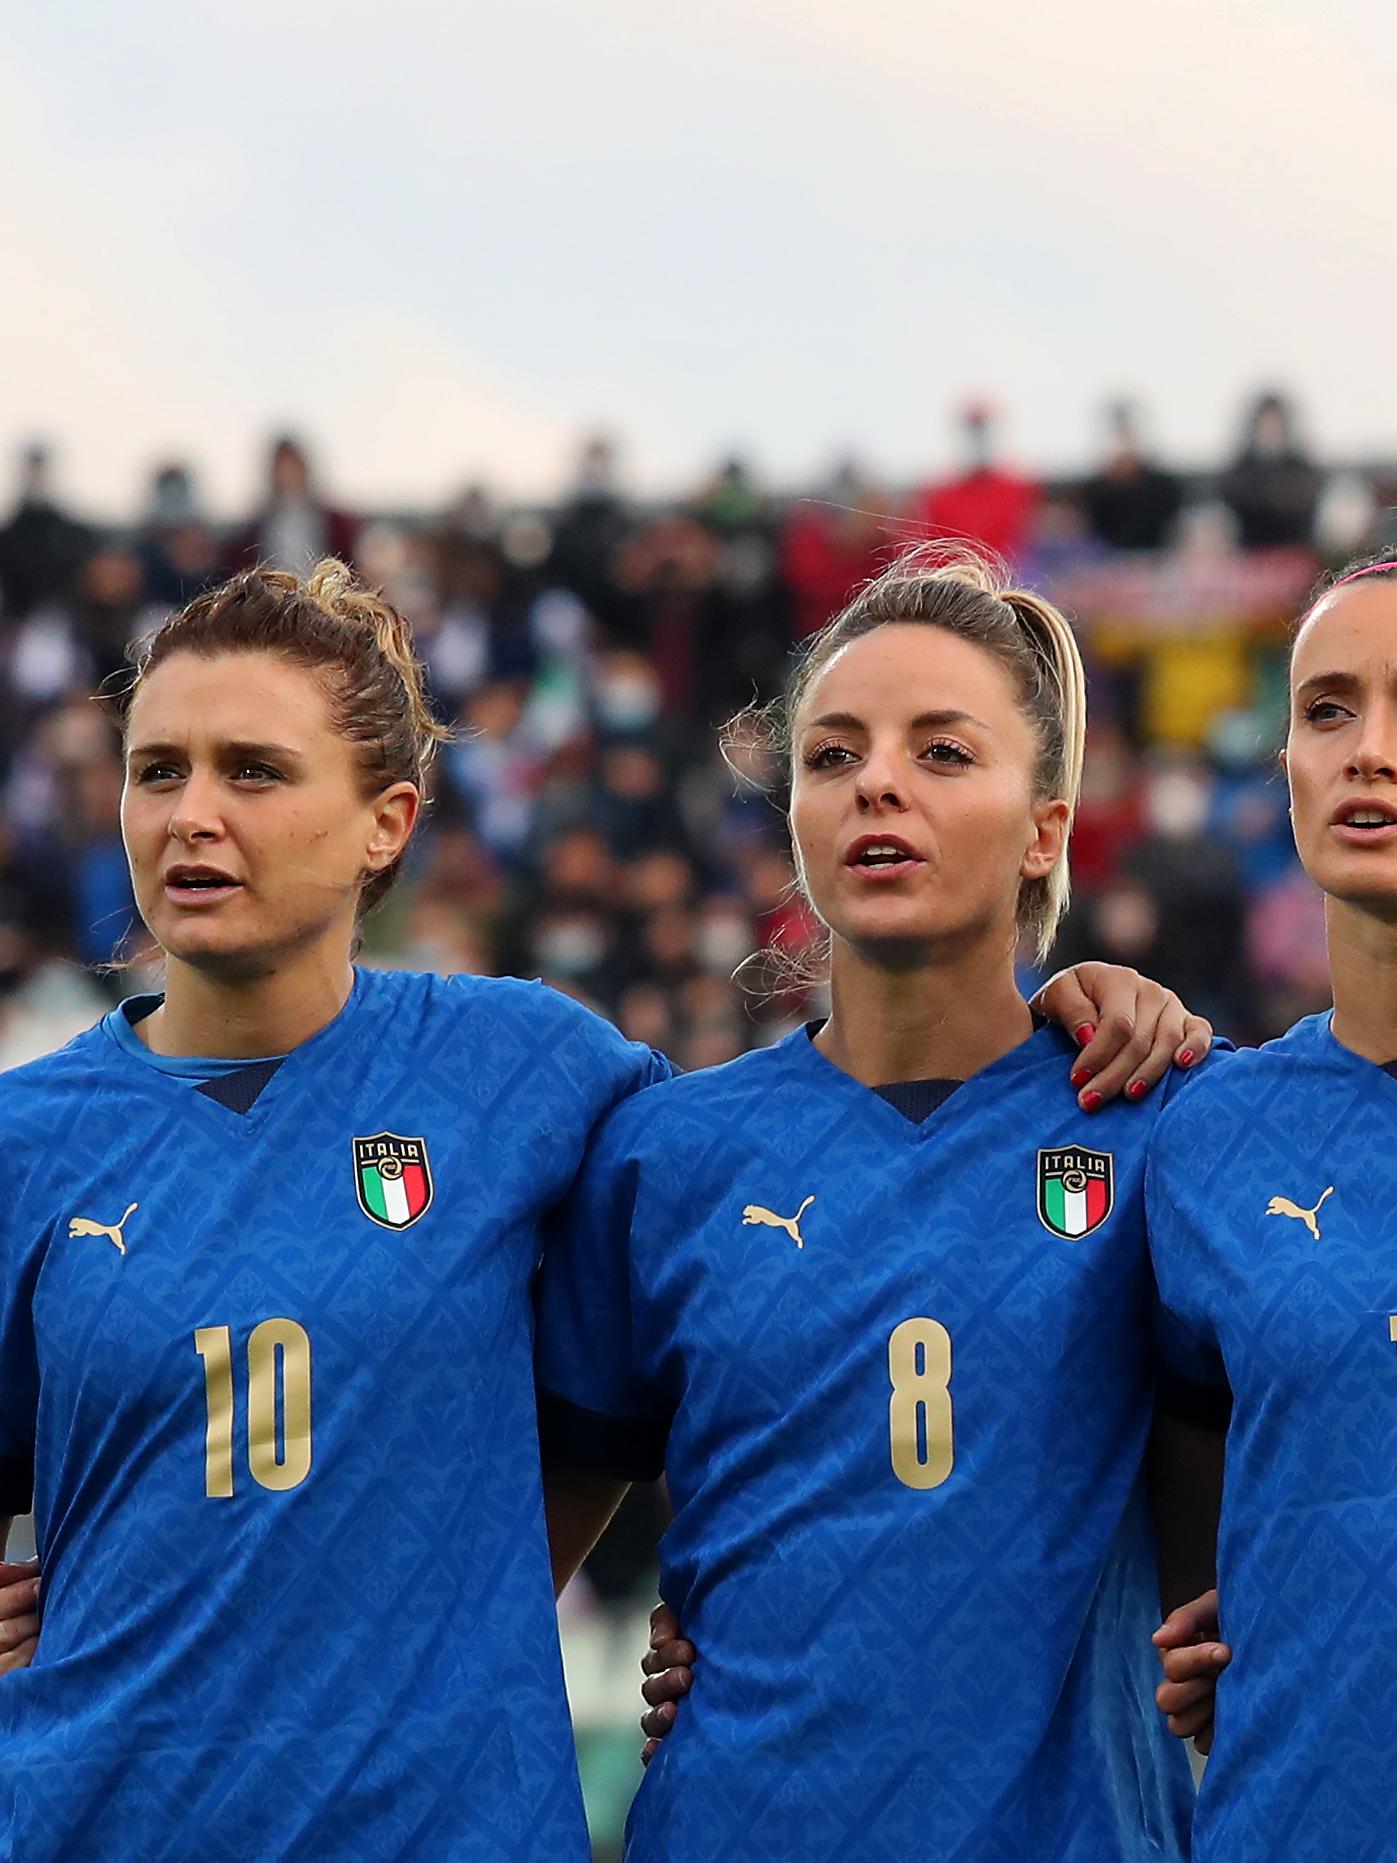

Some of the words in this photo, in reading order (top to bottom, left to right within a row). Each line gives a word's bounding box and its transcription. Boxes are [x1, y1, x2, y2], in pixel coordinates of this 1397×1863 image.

[359, 1142, 419, 1158] ITALIA
[1045, 1155, 1105, 1172] ITALIA
[194, 1317, 312, 1498] 10
[887, 1317, 955, 1491] 8
